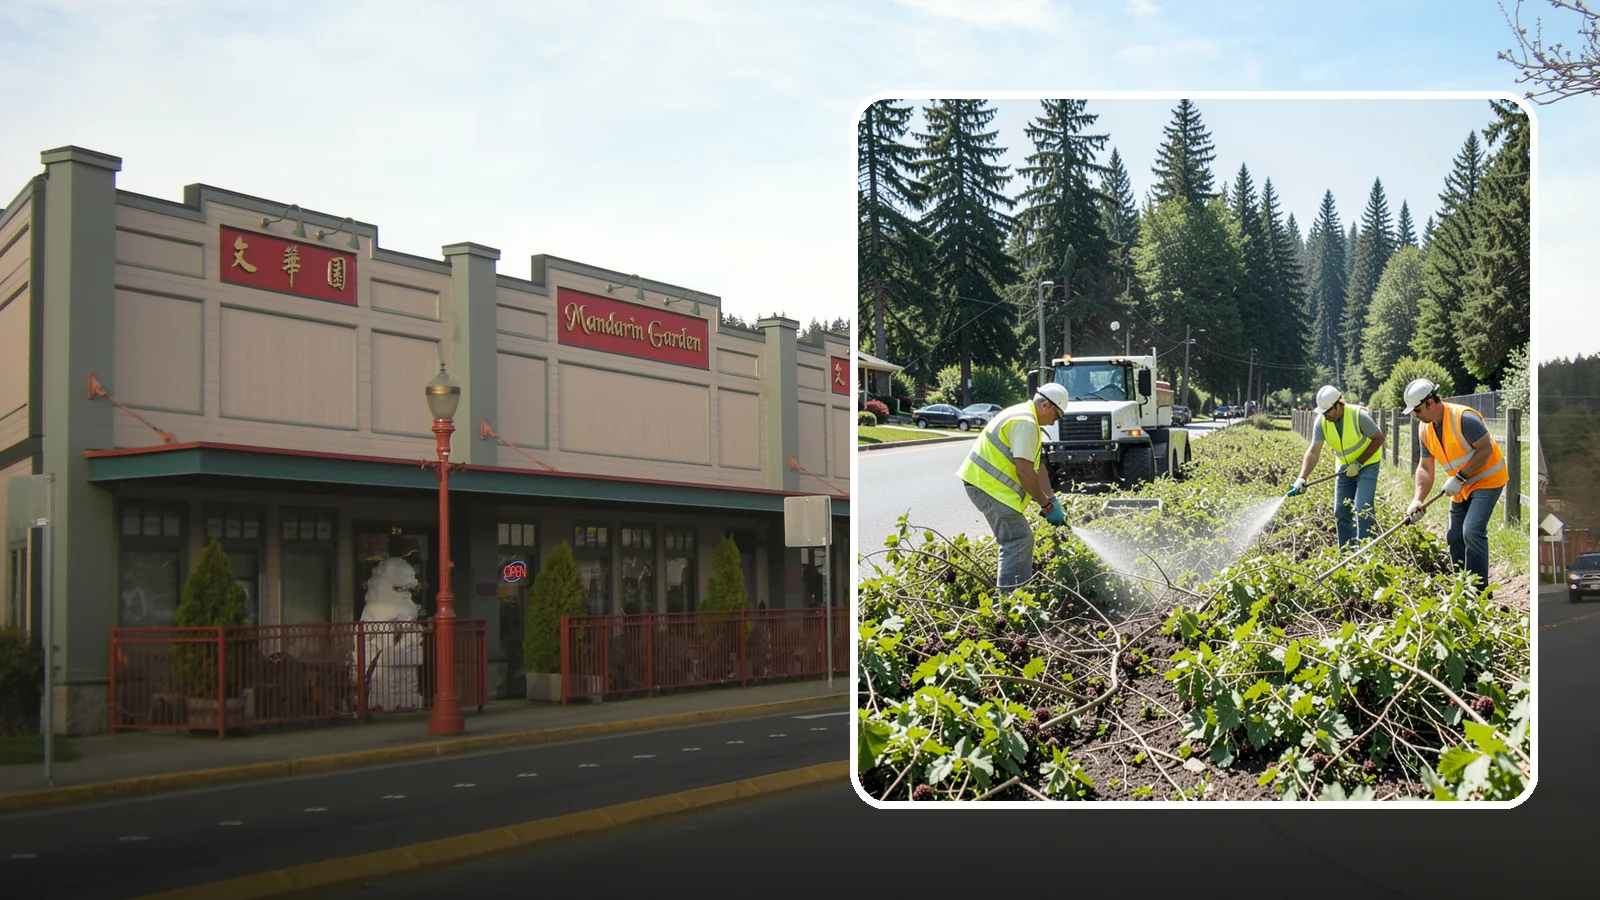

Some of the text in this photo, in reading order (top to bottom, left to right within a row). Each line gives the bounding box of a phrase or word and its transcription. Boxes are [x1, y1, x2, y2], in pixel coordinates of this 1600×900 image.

[230, 235, 346, 291] 文華園
[564, 302, 702, 352] Mandarin Garden
[503, 565, 527, 579] OPEN
